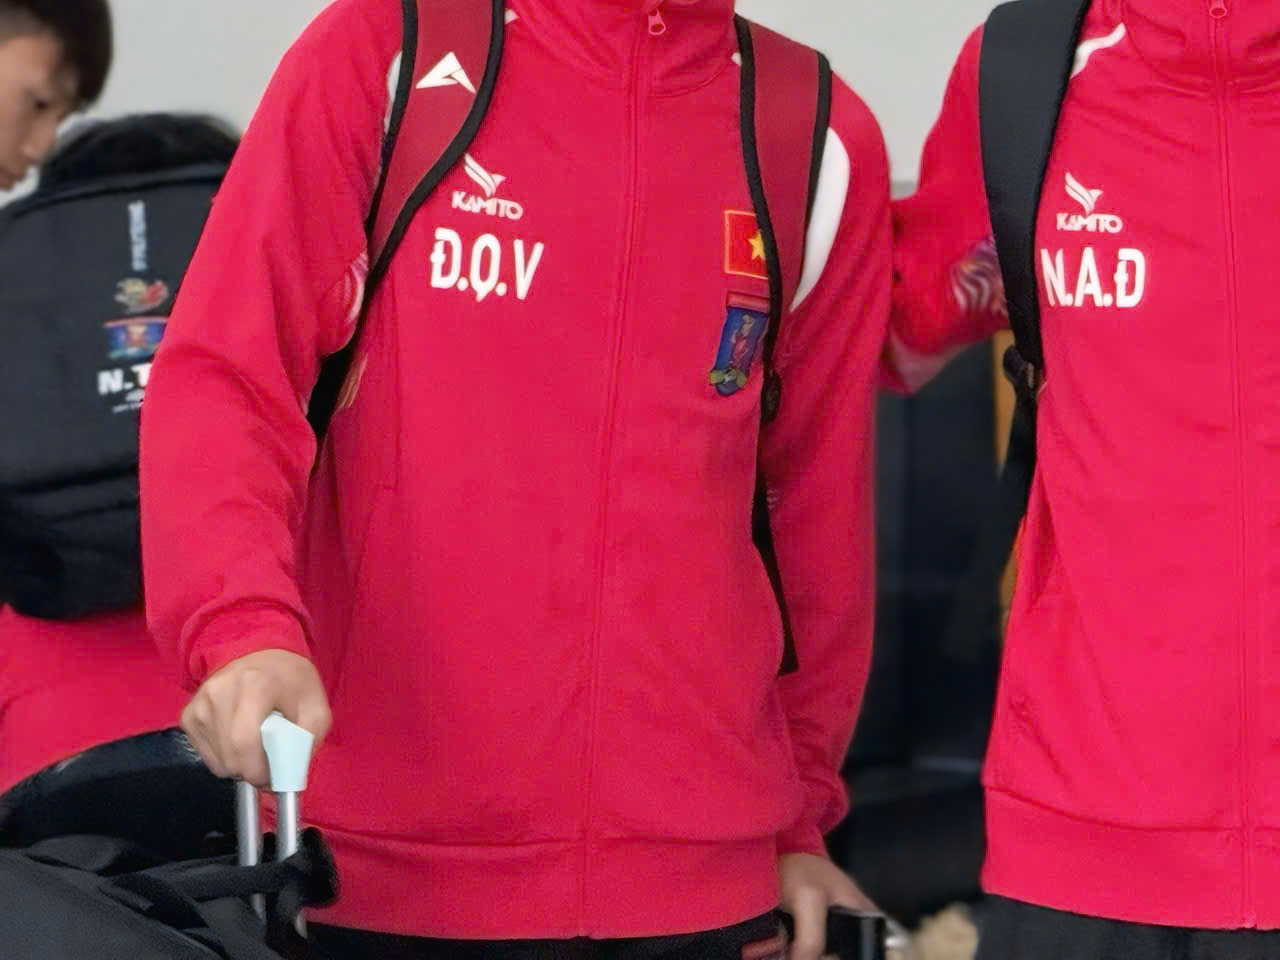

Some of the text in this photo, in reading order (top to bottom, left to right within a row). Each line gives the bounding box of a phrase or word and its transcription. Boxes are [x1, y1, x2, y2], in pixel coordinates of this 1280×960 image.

[452, 190, 523, 220] KAMITO
[1056, 212, 1123, 233] KAMITO
[430, 227, 545, 302] Đ.Q.V
[1040, 246, 1145, 307] N.A.Đ
